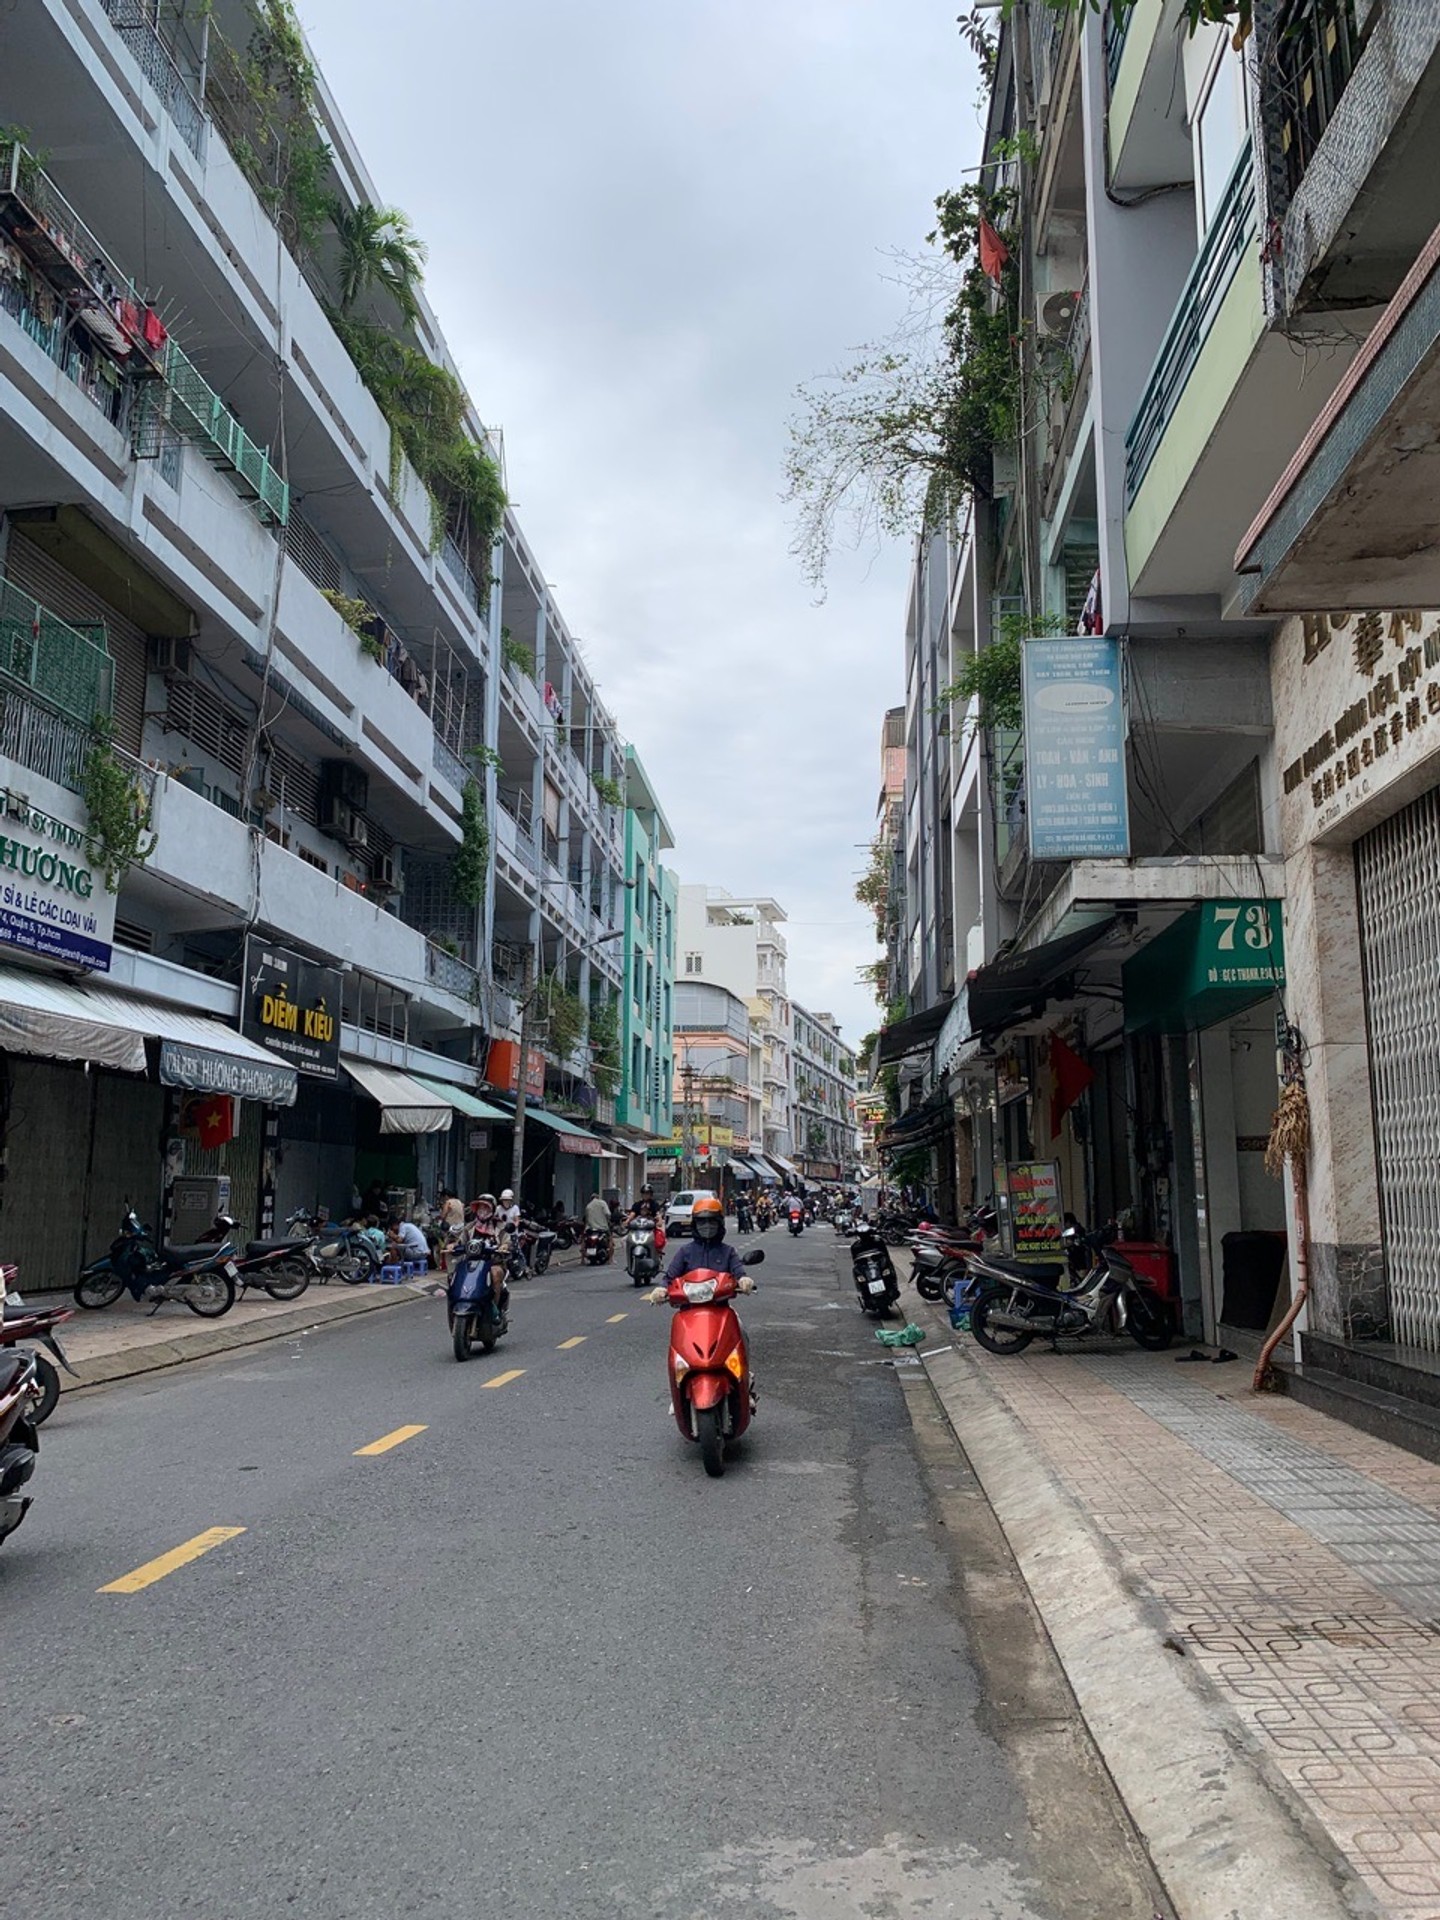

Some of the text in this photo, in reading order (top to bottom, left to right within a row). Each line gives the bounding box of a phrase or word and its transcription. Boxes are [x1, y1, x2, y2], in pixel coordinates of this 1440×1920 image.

[32, 813, 47, 834] SX
[49, 821, 66, 842] TM
[68, 828, 84, 849] DV
[0, 835, 93, 899] HƯƠNG
[3, 883, 97, 934] SỈ & LẺ CÁC LOẠI VẢI
[1214, 905, 1273, 950] 73
[262, 982, 333, 1042] DIỄM KIỀU
[202, 1058, 239, 1090] HƯƠNG
